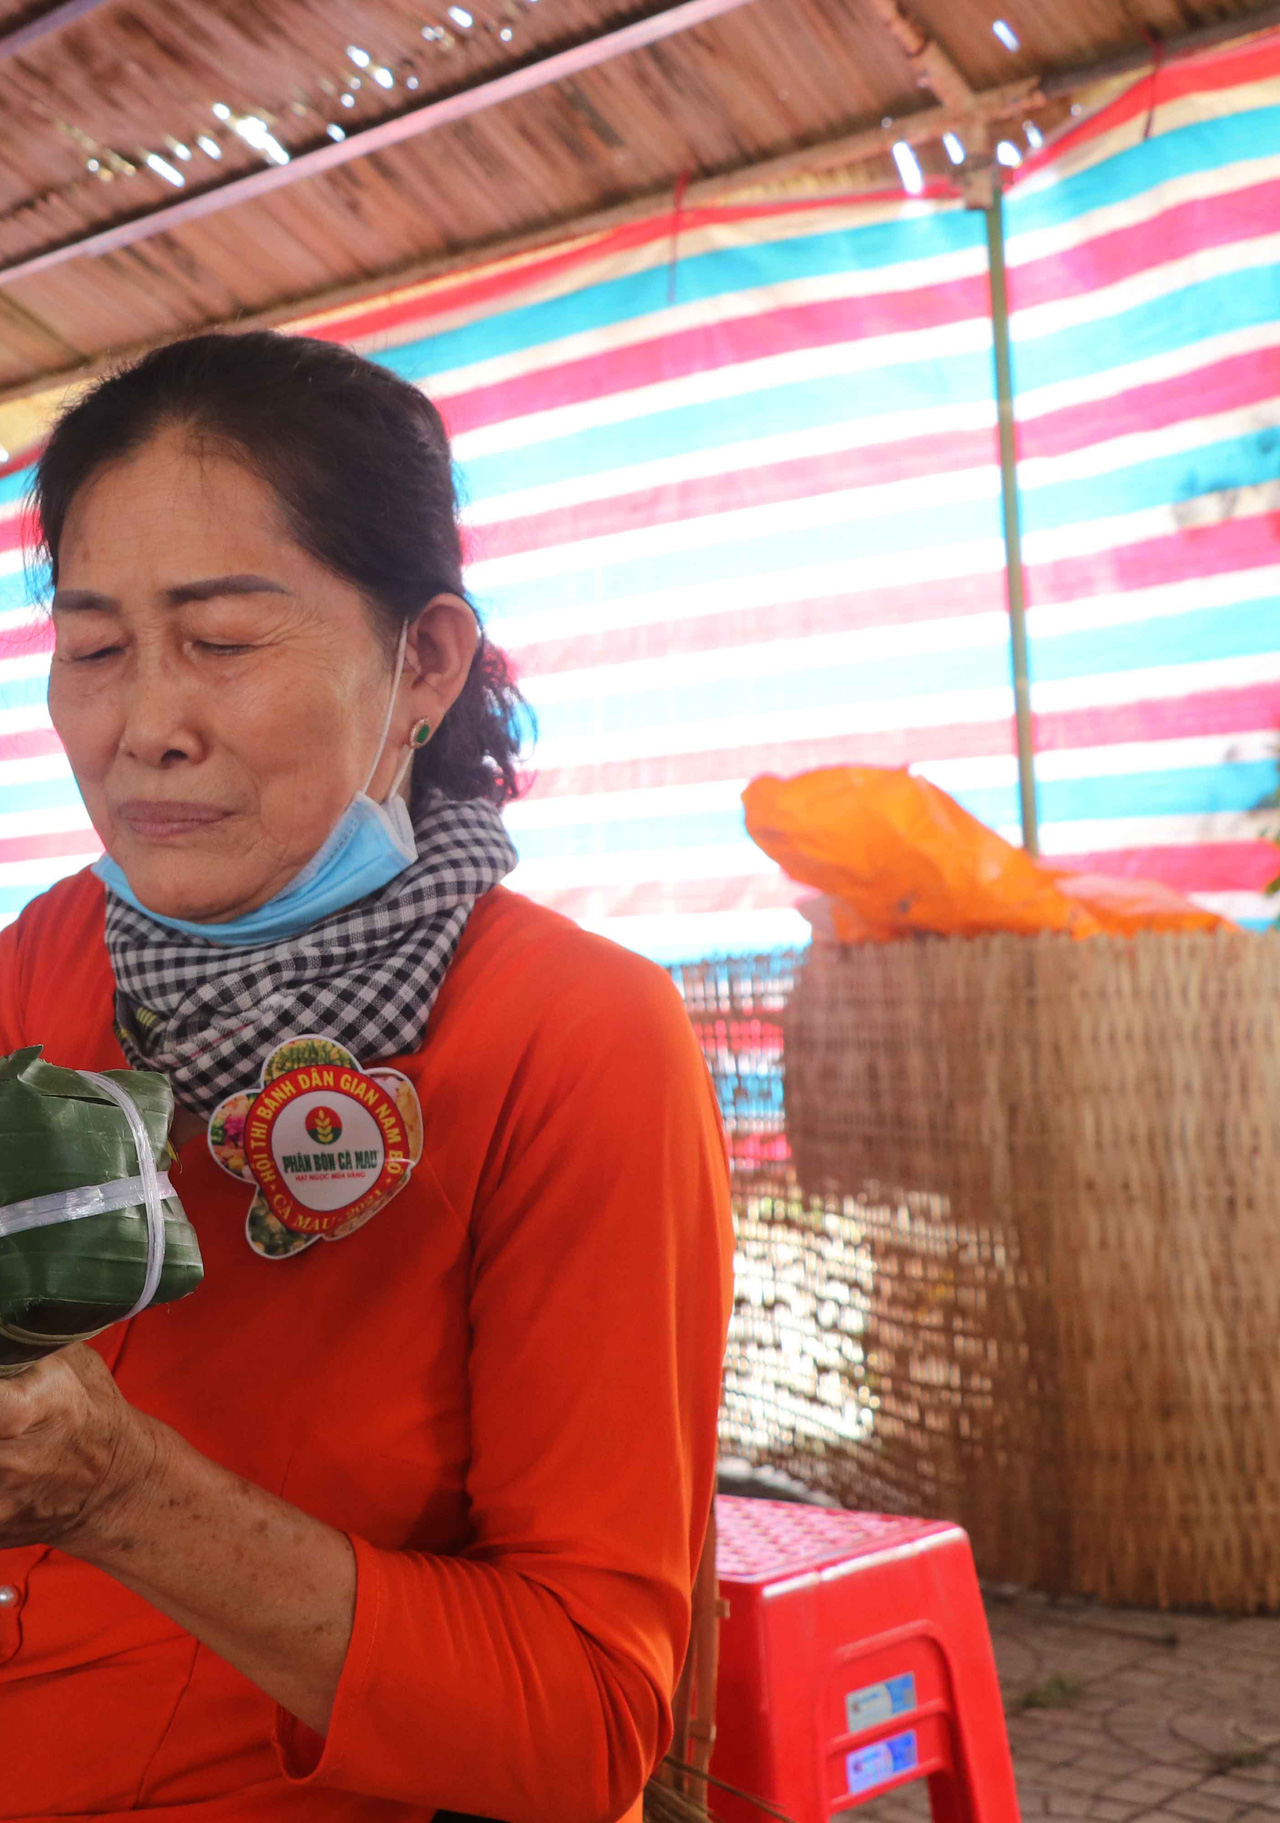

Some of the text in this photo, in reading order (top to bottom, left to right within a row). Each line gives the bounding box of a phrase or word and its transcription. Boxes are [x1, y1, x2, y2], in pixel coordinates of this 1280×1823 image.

[297, 1067, 335, 1090] DÂN
[339, 1073, 380, 1105] GIAN
[256, 1079, 297, 1120] BÁNH
[250, 1121, 269, 1149] THI
[374, 1103, 402, 1144] NAM
[252, 1152, 277, 1183] HỘI
[282, 1148, 378, 1173] PHÂN BÓN CÀ MAU
[274, 1193, 295, 1220] CÀ
[293, 1214, 336, 1230] MAU
